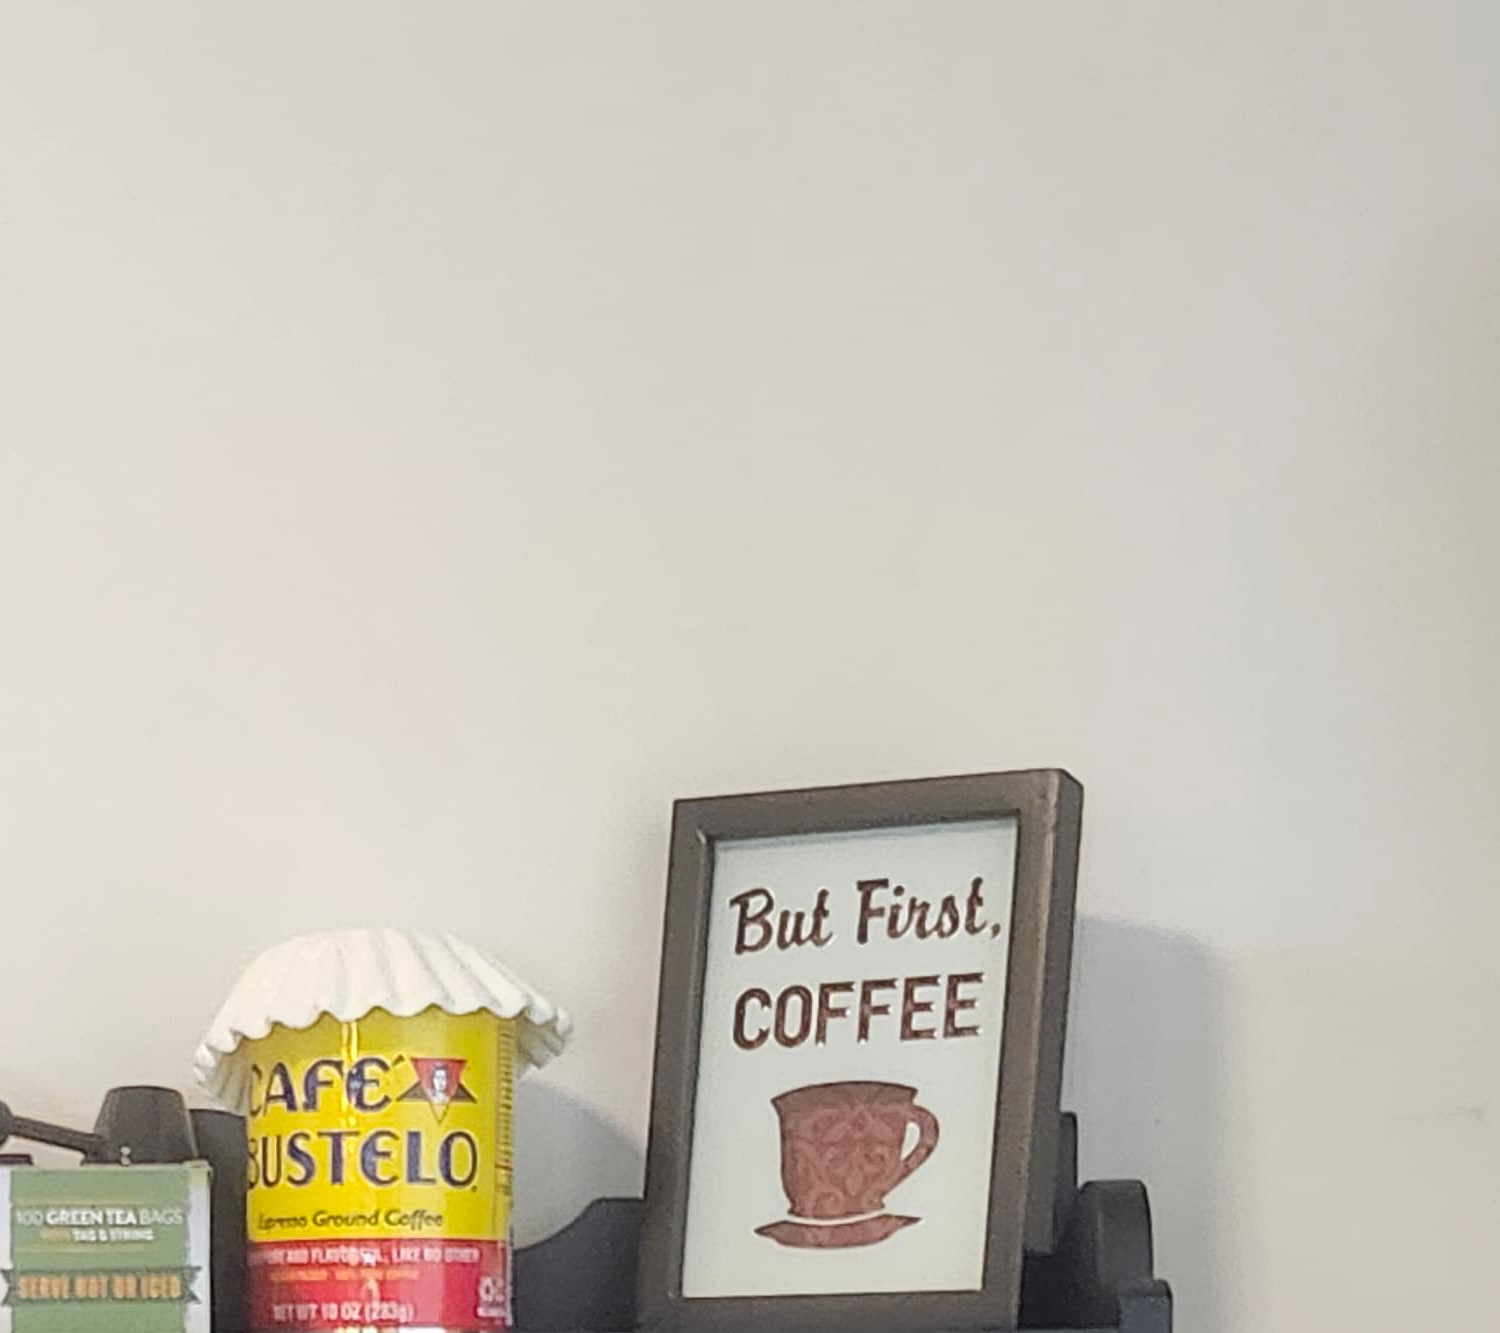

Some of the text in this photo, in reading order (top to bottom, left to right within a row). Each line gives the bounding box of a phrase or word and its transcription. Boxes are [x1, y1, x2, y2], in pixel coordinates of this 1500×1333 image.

[729, 876, 1001, 956] But First,
[732, 972, 985, 1051] COFFEE
[16, 1206, 185, 1226] 100 GREEN TEA BAGS
[312, 1209, 380, 1227] Ground
[384, 1209, 445, 1231] Coffee
[322, 1303, 338, 1321] 10
[342, 1303, 361, 1321] OZ
